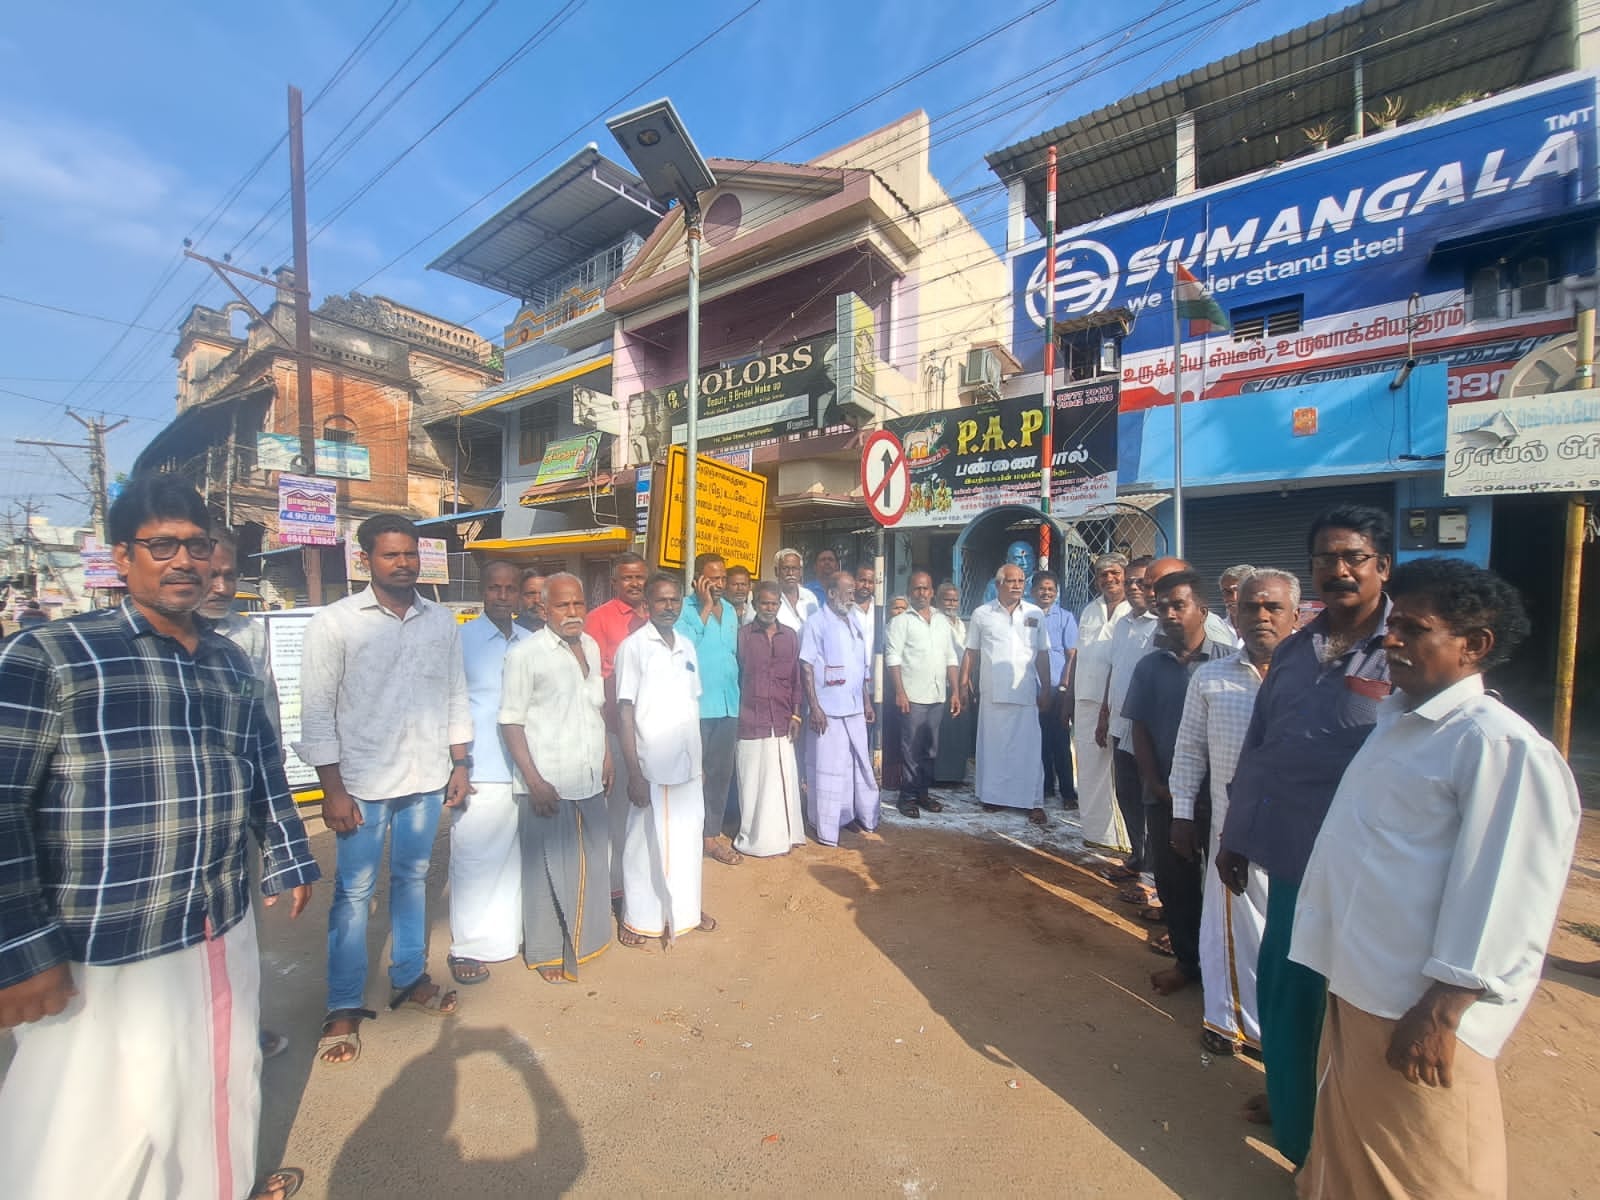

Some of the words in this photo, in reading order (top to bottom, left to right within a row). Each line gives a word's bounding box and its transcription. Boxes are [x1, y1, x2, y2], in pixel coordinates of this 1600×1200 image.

[1544, 105, 1594, 131] TMT
[1127, 130, 1578, 283] SUMANGALA
[1127, 292, 1162, 312] we
[1171, 251, 1328, 304] derstand
[1332, 227, 1405, 267] steel
[957, 409, 1044, 455] P.A.P
[955, 454, 1038, 476] பண்ணை
